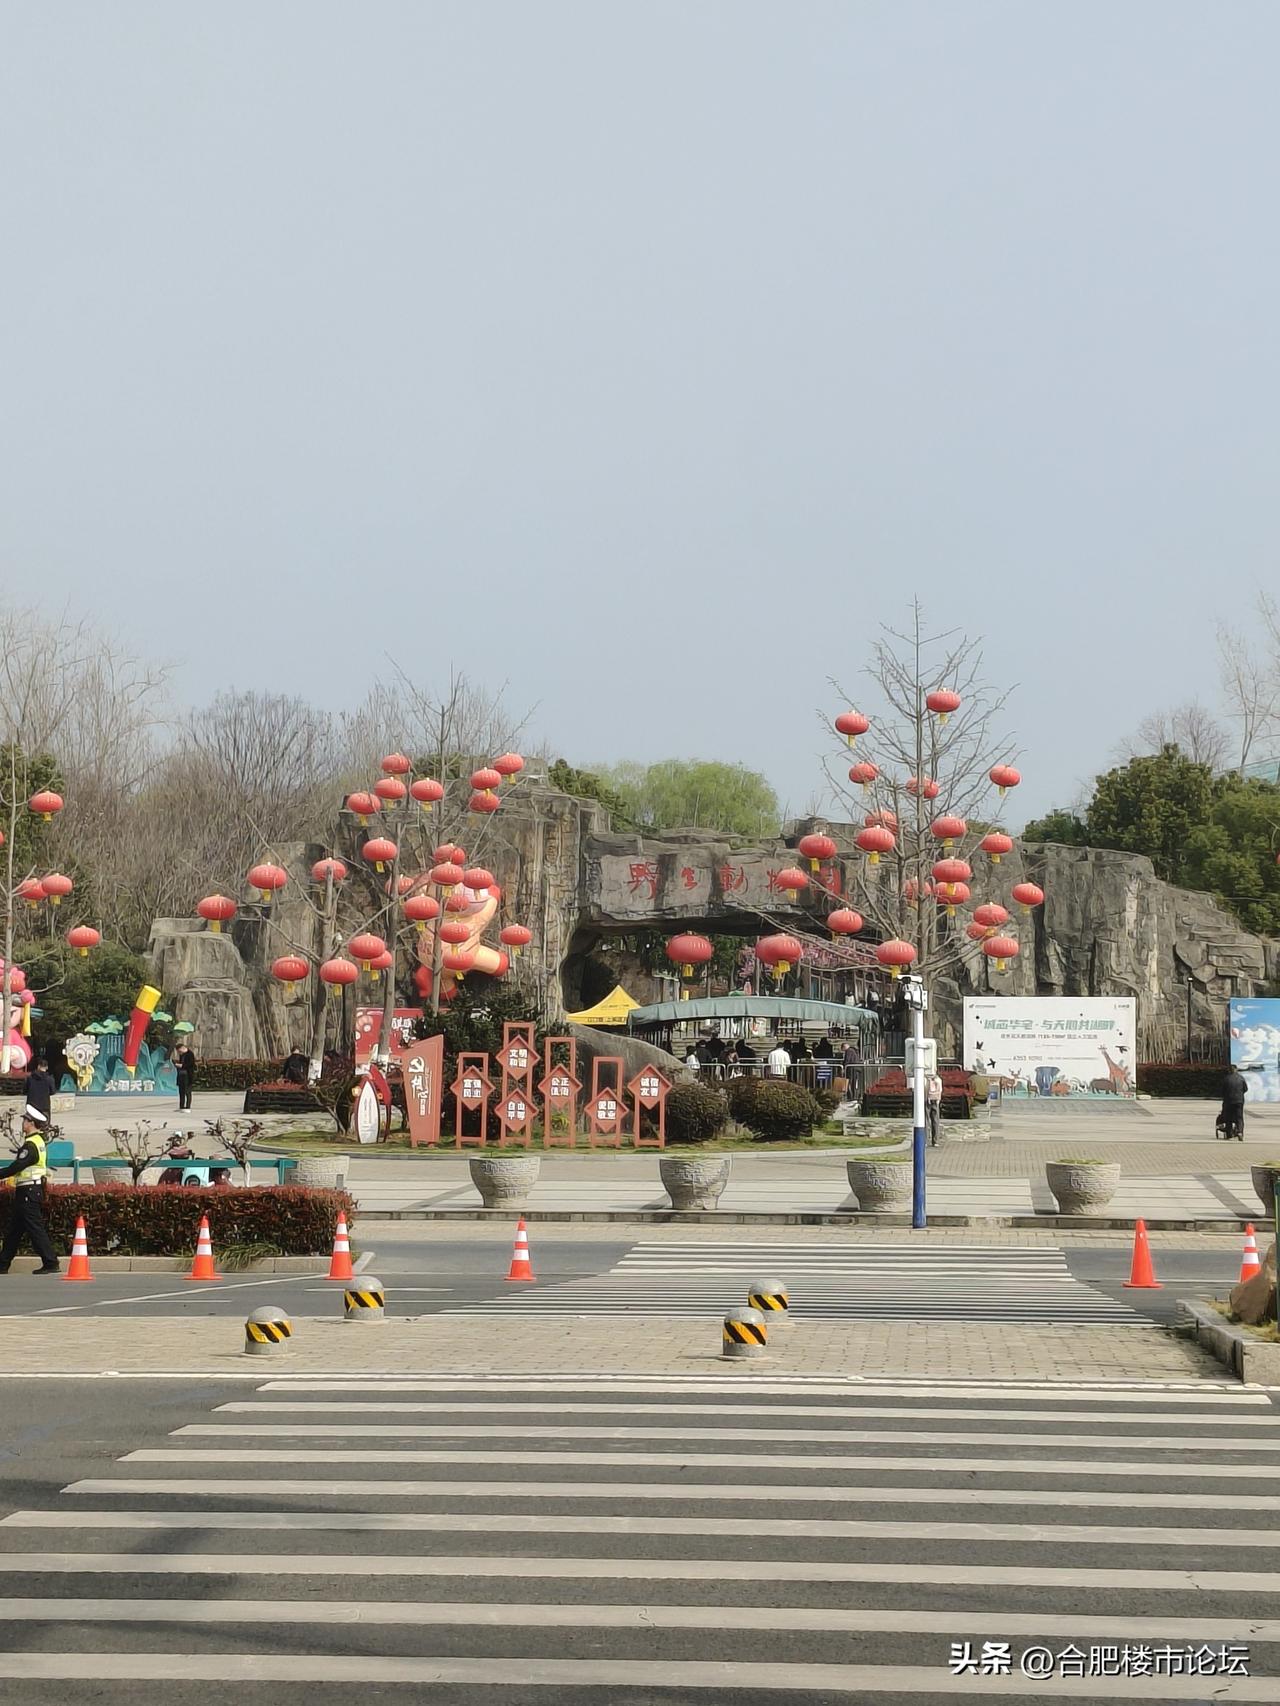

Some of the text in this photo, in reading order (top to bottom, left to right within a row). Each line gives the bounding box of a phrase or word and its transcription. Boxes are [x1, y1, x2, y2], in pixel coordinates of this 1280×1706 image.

[509, 1048, 528, 1058] 文明
[509, 1058, 528, 1068] 和谐
[551, 1077, 569, 1087] 公正
[640, 1077, 659, 1087] 诚信
[508, 1100, 526, 1110] 自由
